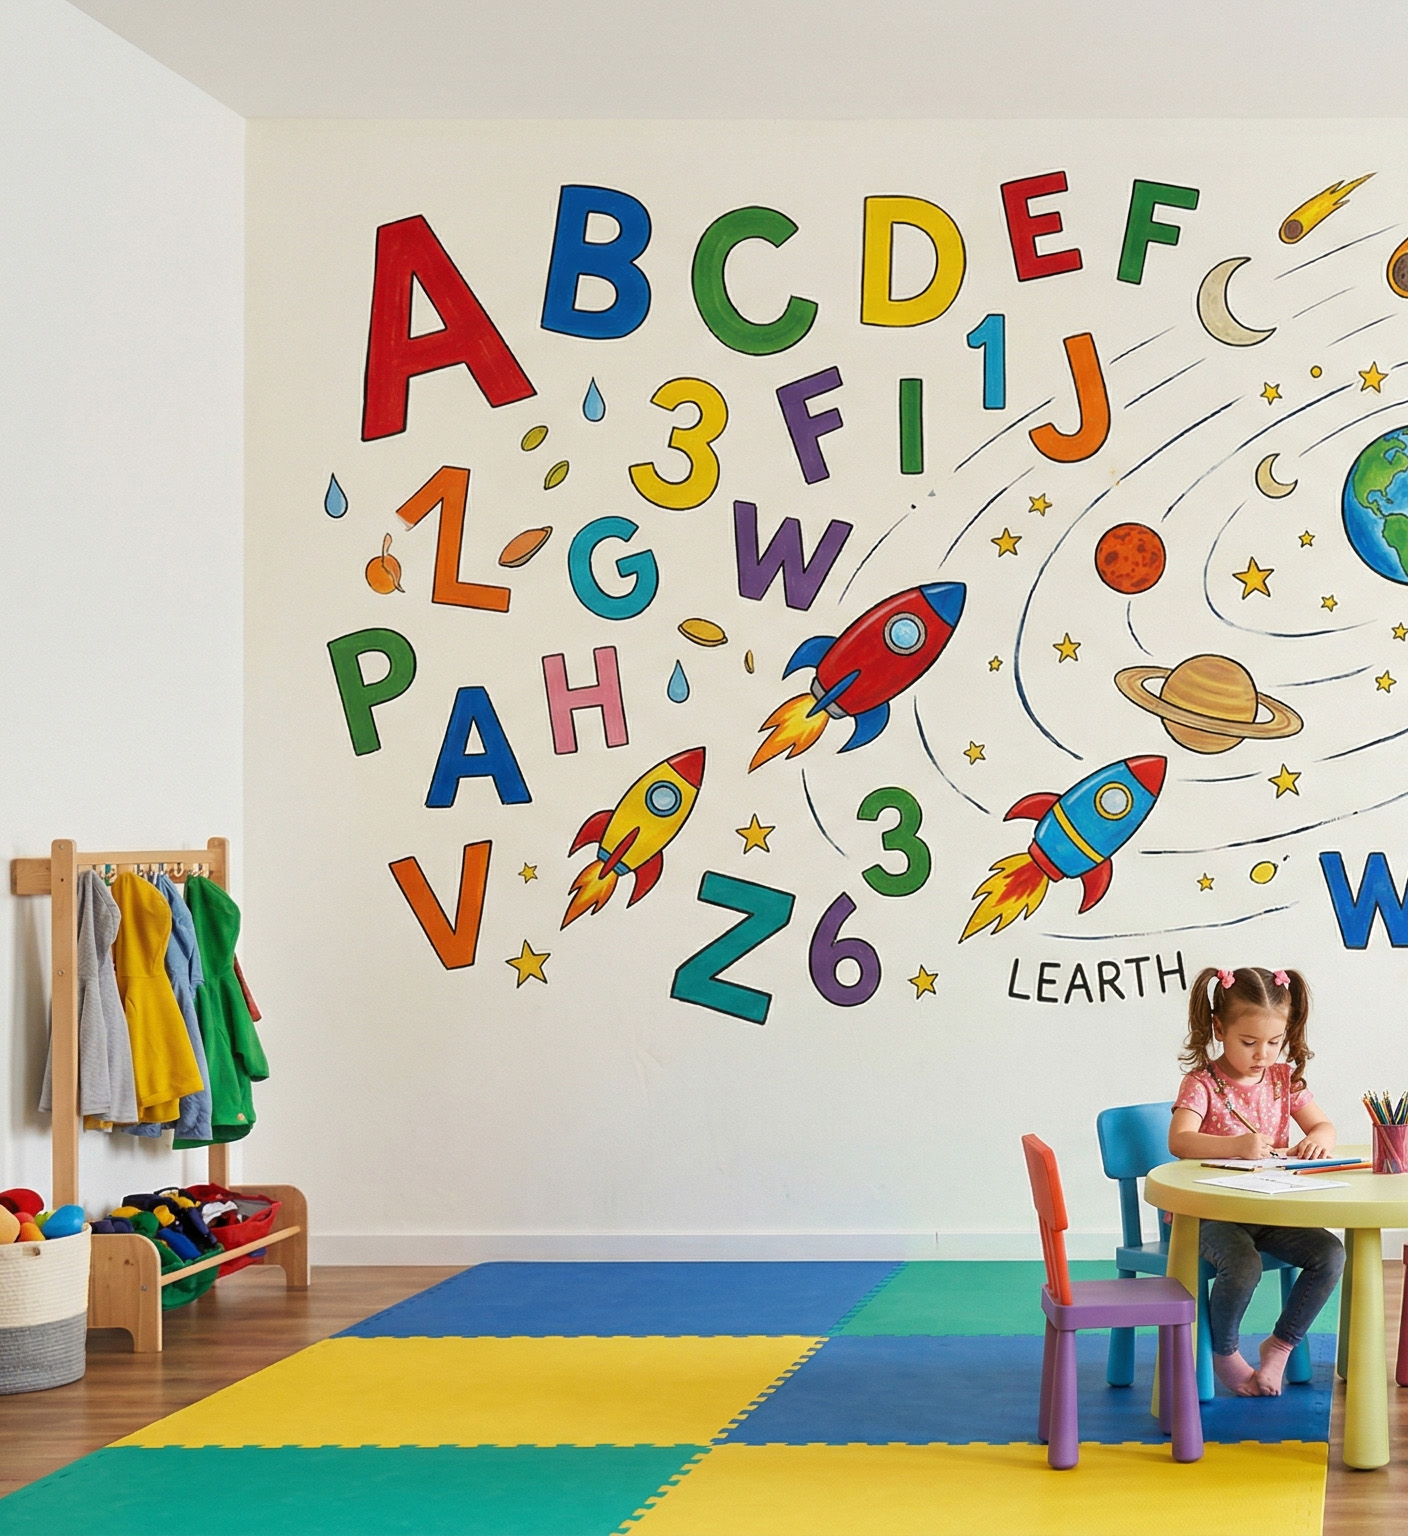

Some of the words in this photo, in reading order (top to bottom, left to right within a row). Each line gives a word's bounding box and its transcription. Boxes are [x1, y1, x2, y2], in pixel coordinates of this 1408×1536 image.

[361, 215, 537, 441] A
[541, 184, 652, 340] B
[691, 206, 818, 356] C
[860, 195, 966, 327] D
[1000, 171, 1083, 282] E
[1117, 179, 1200, 285] F
[629, 377, 728, 511] 3
[776, 366, 843, 485] F
[1029, 333, 1111, 463] J
[568, 516, 659, 620] G
[733, 500, 853, 611] W
[327, 628, 417, 756] P
[425, 686, 532, 808] A
[542, 646, 629, 755] H
[857, 787, 931, 897] 3
[388, 840, 492, 970] V
[670, 871, 796, 1025] Z
[809, 892, 881, 1007] 6
[1009, 951, 1186, 1004] LEARTH
